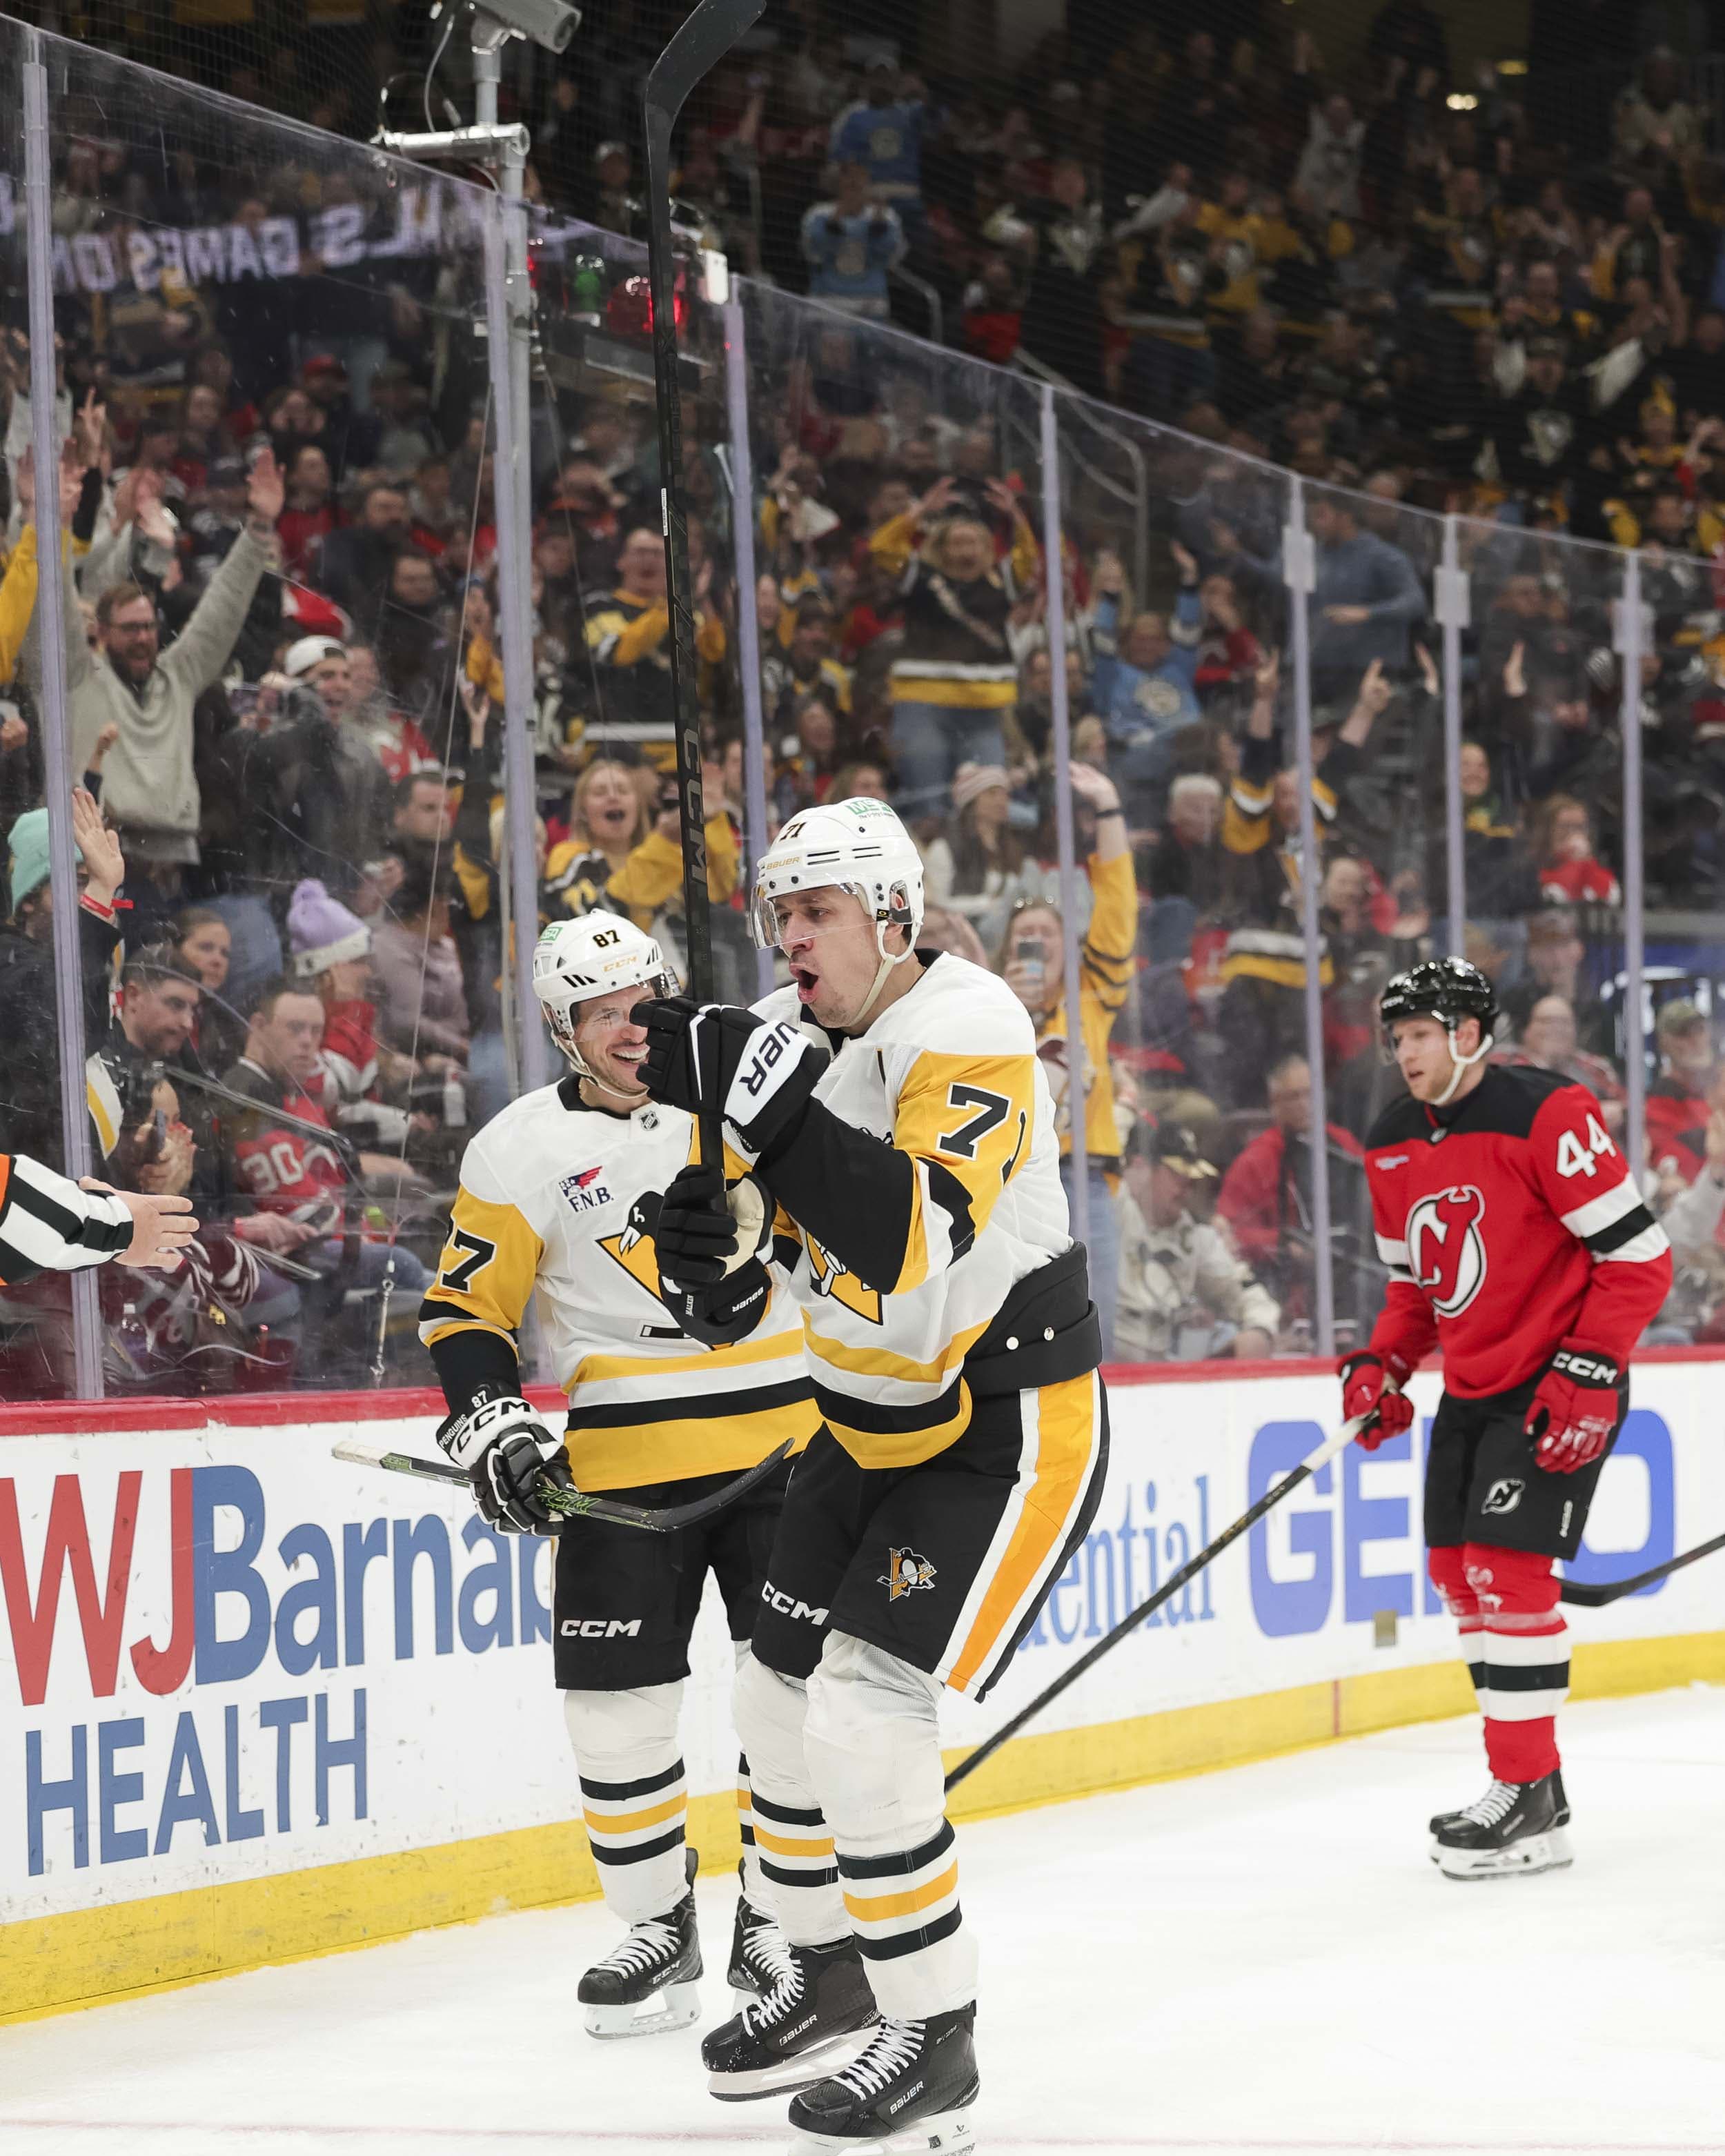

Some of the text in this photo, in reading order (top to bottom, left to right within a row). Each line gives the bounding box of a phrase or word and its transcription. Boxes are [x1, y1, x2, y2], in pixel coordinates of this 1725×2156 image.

[682, 727, 707, 886] CCM
[778, 822, 808, 842] 71
[766, 856, 801, 871] BAUER
[592, 929, 622, 948] 87
[603, 956, 638, 972] CCM
[739, 1022, 801, 1097] UER
[1556, 1111, 1617, 1178] 44
[241, 1142, 304, 1195] 30
[568, 1187, 615, 1212] F.N.B.
[439, 1212, 497, 1294] 7
[731, 1286, 764, 1313] BAUER
[1552, 1352, 1618, 1385] CCM
[471, 1390, 488, 1408] 87
[438, 1414, 468, 1449] PENGUINS
[457, 1401, 531, 1454] CCM
[1248, 1409, 1675, 1637] GEO
[1018, 1475, 1215, 1651] ential
[0, 1465, 552, 1707] WJBarnab
[761, 1580, 830, 1625] CCM
[560, 1619, 642, 1637] CCM
[25, 1688, 368, 1877] HEALTH
[779, 2013, 818, 2047] BAUER
[889, 2080, 925, 2115] BAUER
